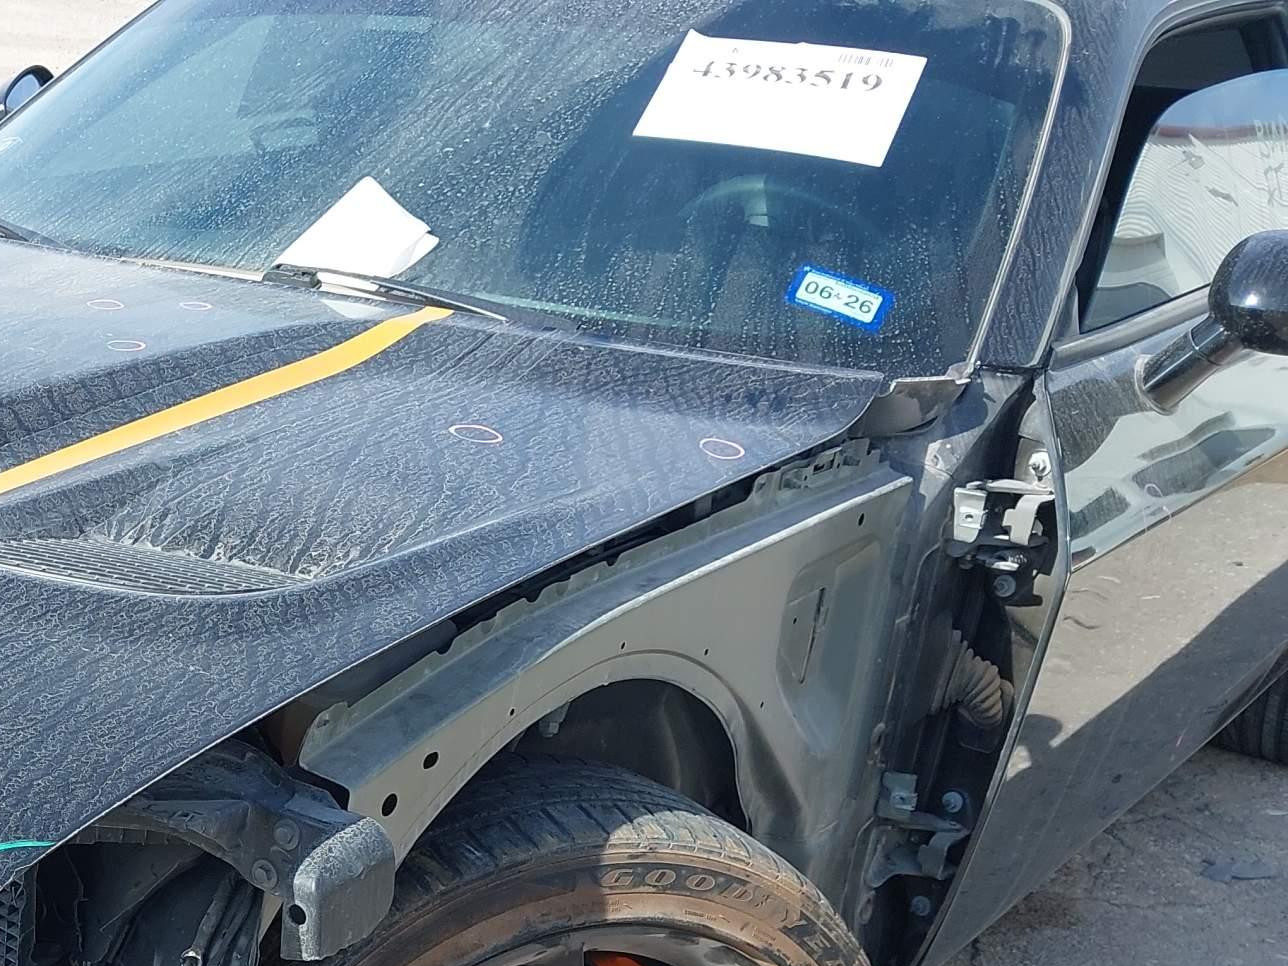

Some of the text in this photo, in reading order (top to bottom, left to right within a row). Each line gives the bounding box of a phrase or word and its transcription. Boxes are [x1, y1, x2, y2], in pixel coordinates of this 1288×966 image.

[693, 60, 883, 92] 43983519
[804, 280, 834, 300] 06
[843, 294, 874, 314] 26
